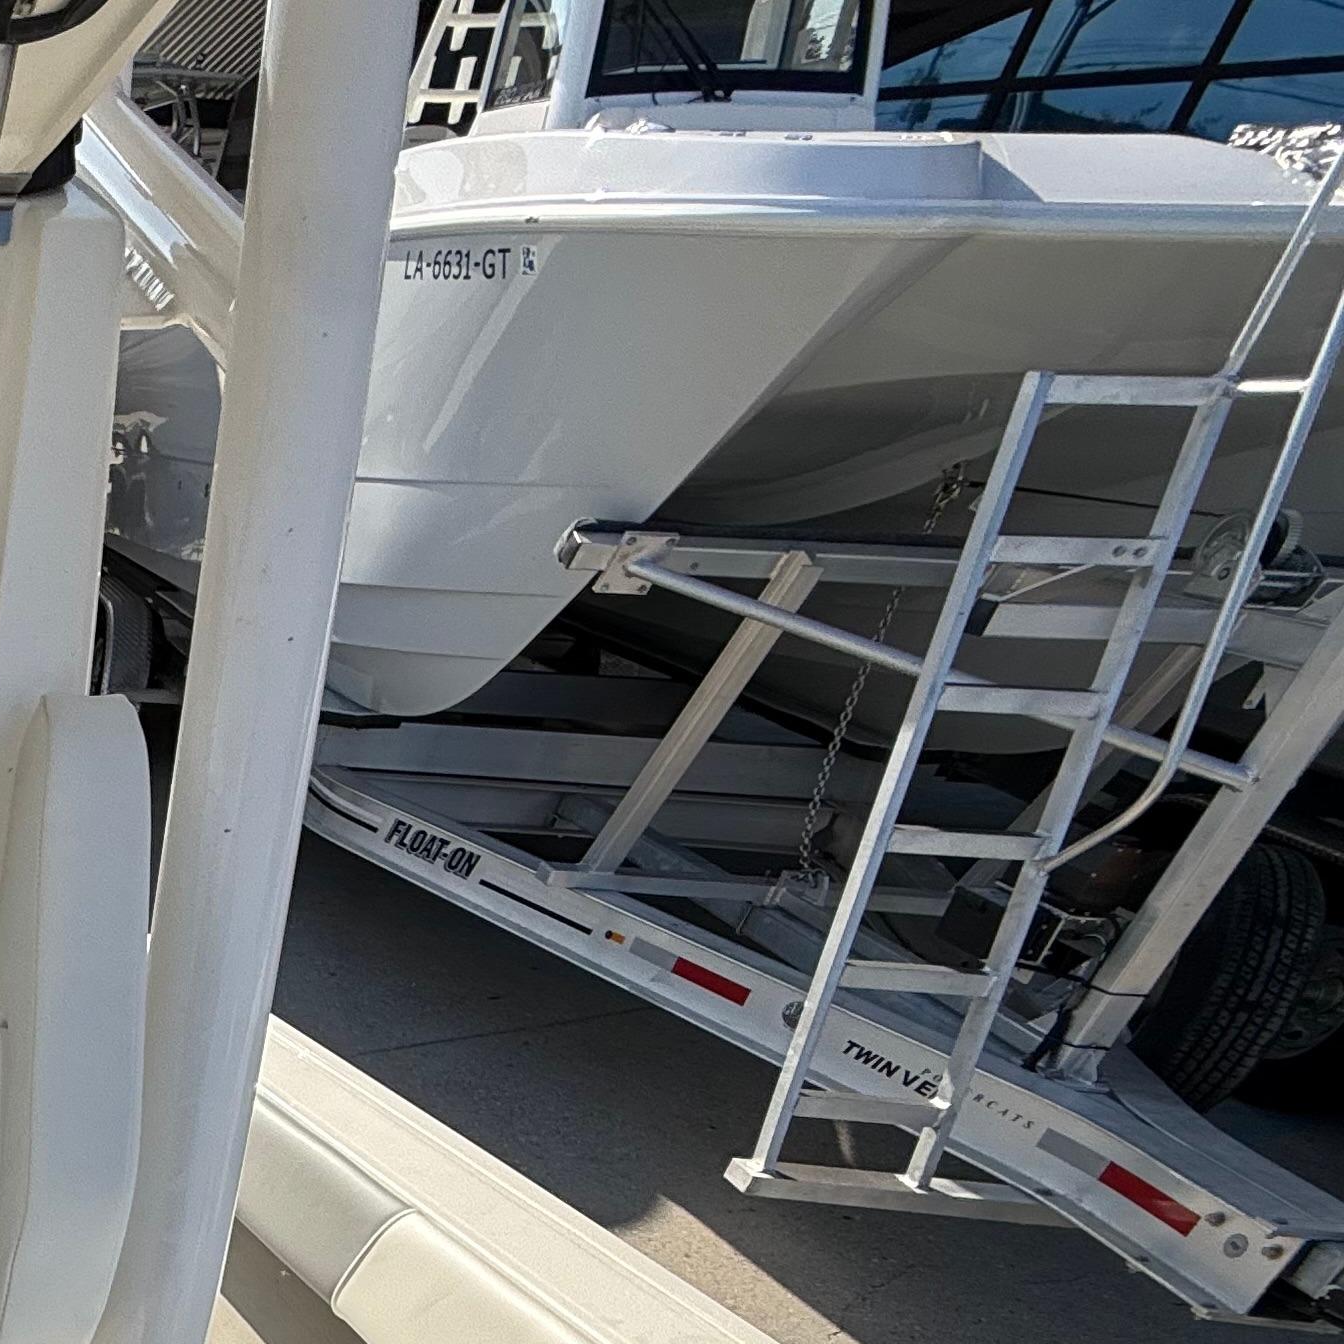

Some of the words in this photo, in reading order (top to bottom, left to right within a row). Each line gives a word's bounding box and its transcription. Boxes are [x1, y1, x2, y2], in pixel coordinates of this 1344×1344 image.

[403, 248, 511, 280] LA-6631-GT
[382, 818, 482, 880] FLOAT-ON
[842, 1040, 900, 1078] TWIN
[902, 1070, 940, 1099] VE
[919, 1068, 1038, 1130] PORCATS
